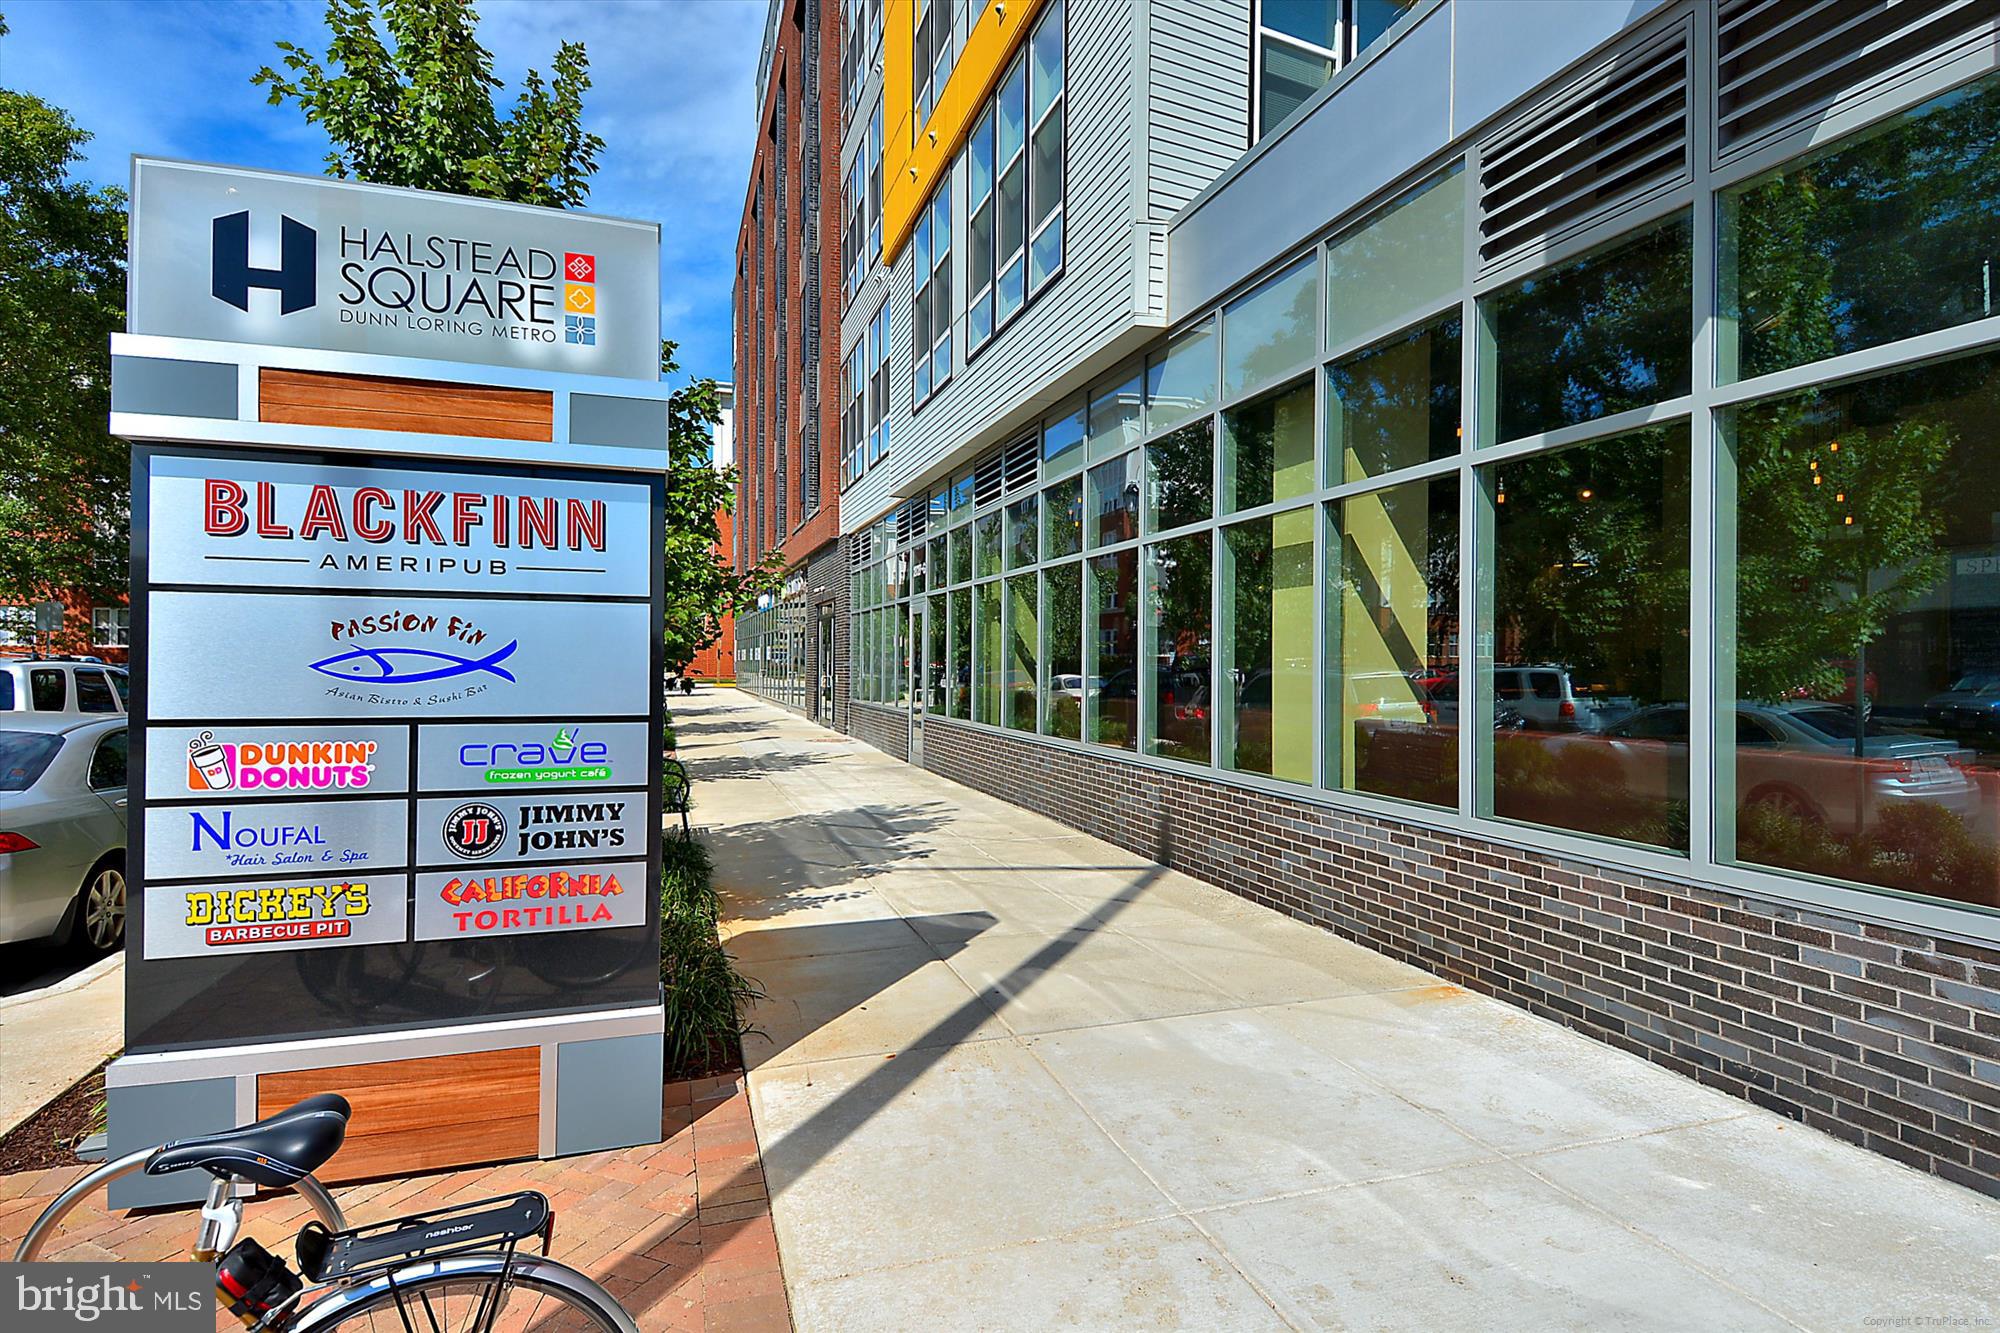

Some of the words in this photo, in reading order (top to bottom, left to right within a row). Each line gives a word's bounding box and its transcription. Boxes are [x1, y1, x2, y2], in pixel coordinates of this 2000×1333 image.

[341, 225, 557, 281] HALSTEAD
[338, 262, 555, 325] SQUARE
[340, 309, 398, 327] DUNN
[407, 316, 483, 336] LORING
[492, 325, 556, 343] METRO
[204, 478, 607, 552] BLACKFINN
[319, 554, 508, 576] AMERIPUB
[325, 686, 363, 702] Asian
[367, 693, 408, 705] Bistro
[413, 697, 422, 706] &
[427, 692, 462, 706] Sushi
[464, 683, 489, 698] Bar
[240, 742, 376, 766] DUNKIN'
[460, 741, 608, 766] crave
[240, 765, 369, 788] DONUTS
[489, 770, 531, 780] frozen
[535, 769, 577, 780] yogurt
[580, 767, 607, 778] café
[448, 807, 474, 833] JIMMY
[518, 802, 625, 830] JIMMY
[188, 811, 326, 852] NOUFAL
[461, 818, 490, 845] JJ
[518, 828, 625, 856] JOHN'S
[272, 851, 314, 866] Salon
[321, 850, 334, 862] &
[339, 849, 369, 864] Spa
[440, 871, 624, 907] CALIFORNIA
[452, 903, 613, 932] TORTILLA
[209, 923, 311, 942] BARBECUE
[316, 921, 345, 935] PIT
[424, 1223, 474, 1239] nashbar
